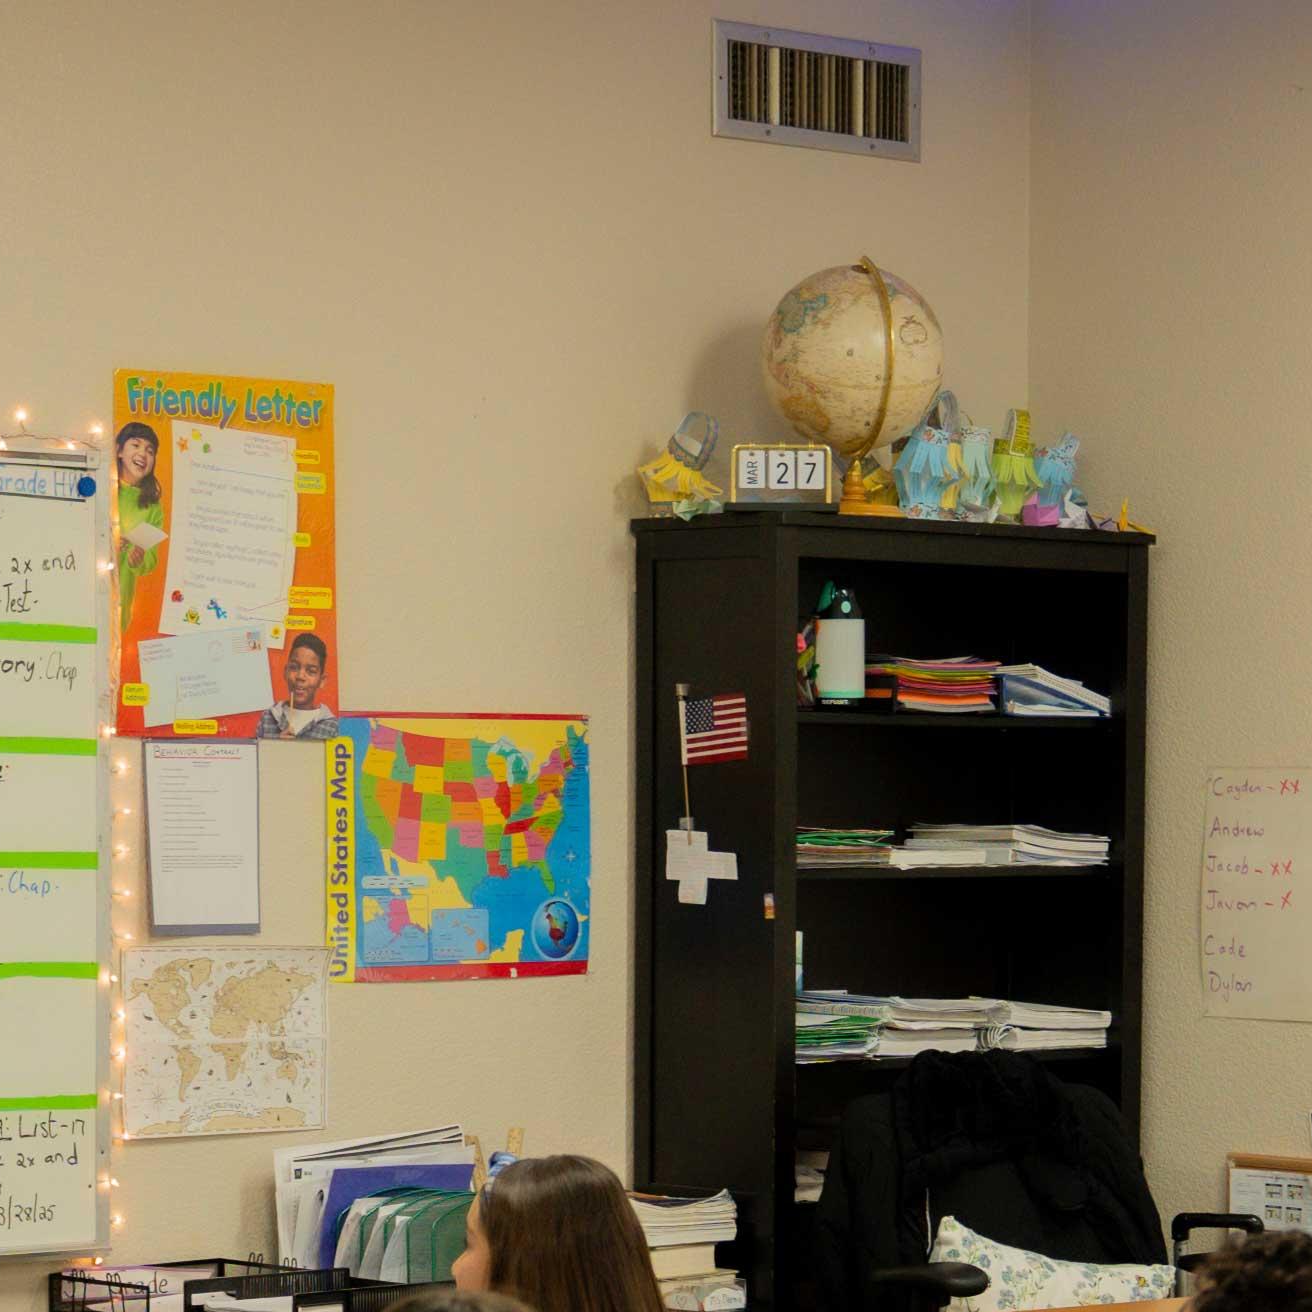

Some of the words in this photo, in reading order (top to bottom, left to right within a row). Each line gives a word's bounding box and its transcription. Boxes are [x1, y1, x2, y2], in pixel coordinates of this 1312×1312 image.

[126, 376, 237, 430] Friendly
[243, 387, 323, 427] Letter
[746, 461, 759, 485] MAR
[330, 742, 352, 801] Map
[1209, 815, 1265, 838] Andrew
[330, 807, 349, 886] States
[1207, 855, 1249, 876] Jacob
[329, 892, 350, 978] United
[1208, 970, 1253, 1003] Dylan
[44, 1142, 79, 1166] and
